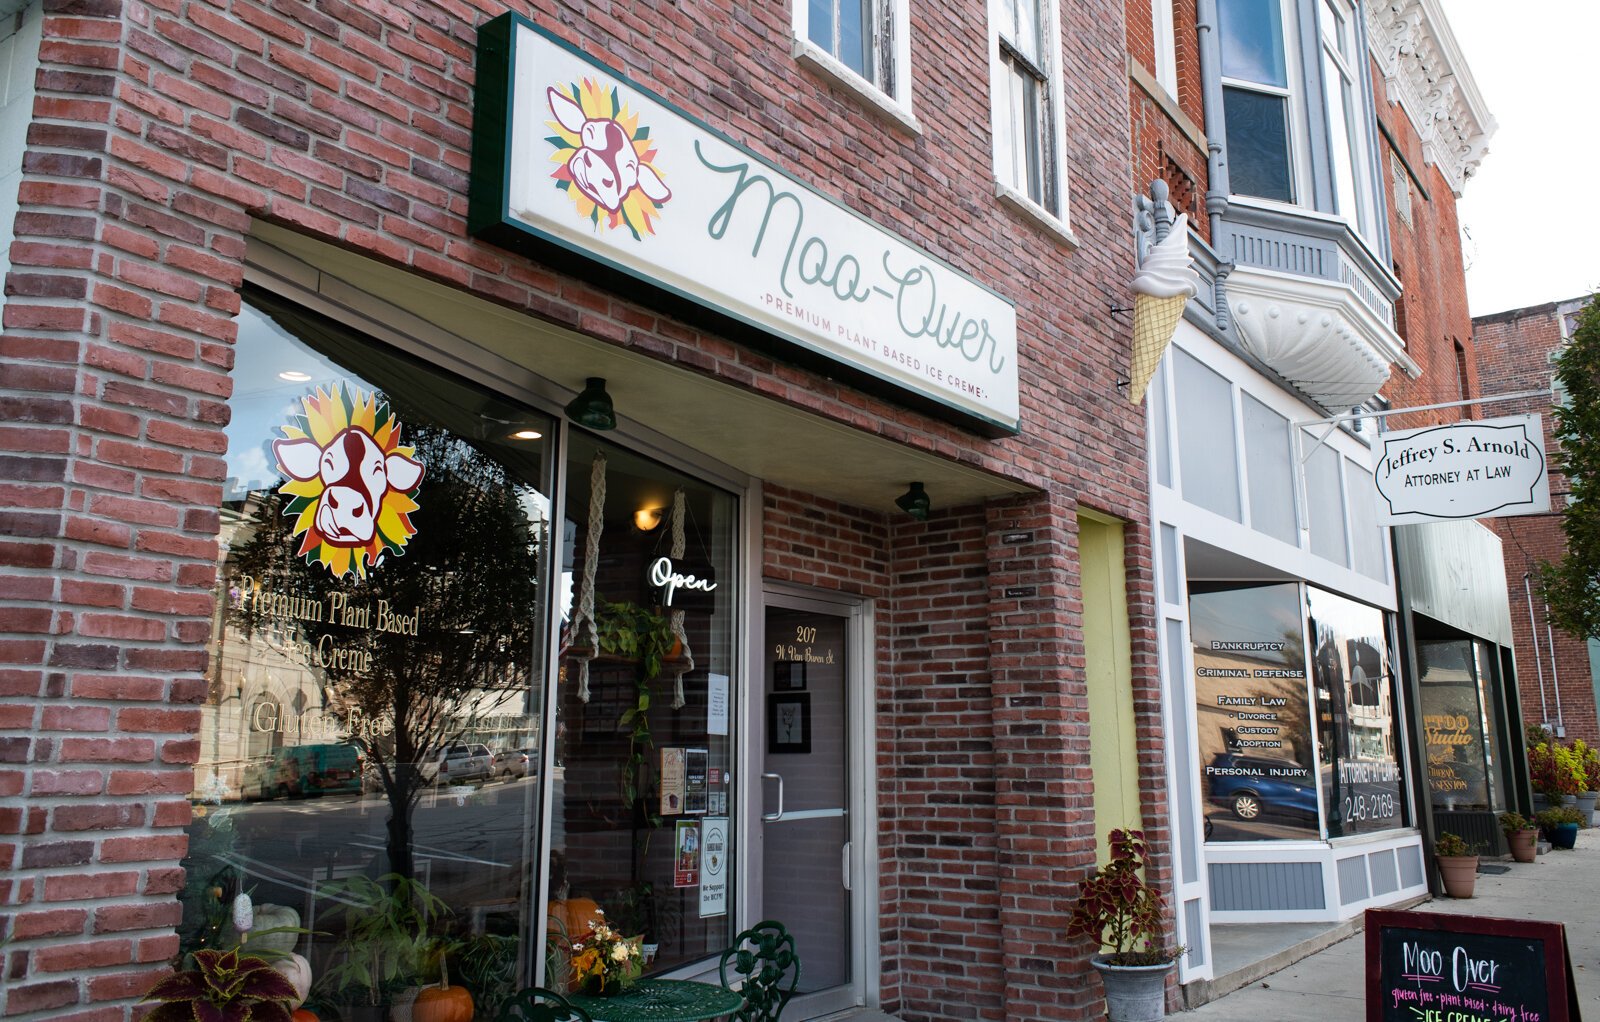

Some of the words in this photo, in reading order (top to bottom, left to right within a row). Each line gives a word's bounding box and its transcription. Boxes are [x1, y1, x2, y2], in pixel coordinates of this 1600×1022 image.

[766, 293, 832, 332] PREMIUM
[838, 325, 878, 351] PLANT
[883, 345, 921, 371] BASED
[926, 364, 943, 382] ICE
[1385, 446, 1438, 479] Jeffrey
[1443, 438, 1461, 455] S.
[1466, 436, 1530, 460] Arnold
[1404, 470, 1461, 488] ATTORNEY
[1466, 469, 1480, 482] AT
[1485, 465, 1512, 480] LAW
[652, 556, 718, 607] Open
[238, 574, 322, 623] Premium
[328, 590, 373, 630] Plant
[375, 599, 420, 637] Based
[796, 625, 817, 644] 207
[318, 633, 374, 673] Creme
[787, 644, 804, 662] Van
[804, 646, 825, 663] Buren
[1211, 640, 1284, 651] BANKRUPTCY
[1197, 667, 1250, 678] CRIMINAL
[1253, 669, 1304, 678] DEFENSE
[1217, 696, 1257, 706] FAMILY
[1261, 696, 1287, 706] LAW
[253, 701, 336, 736] Gluten
[346, 706, 393, 738] Free
[1237, 712, 1277, 721] DIVORCE
[1236, 727, 1279, 735] CUSTODY
[1425, 728, 1473, 745] Studio
[1236, 740, 1282, 748] ADOPTION
[1206, 766, 1265, 776] PERSONAL
[1269, 767, 1308, 777] INJURY
[1339, 759, 1372, 784] ATTORNEY
[1402, 941, 1443, 989] Moo
[1452, 946, 1500, 992] Over
[1391, 988, 1419, 1009] gluten
[1419, 988, 1434, 1006] free
[1440, 993, 1462, 1011] plant
[1464, 996, 1485, 1012] based
[1492, 1000, 1518, 1022] dairy
[1520, 1004, 1541, 1022] free
[1425, 1009, 1443, 1022] ICE
